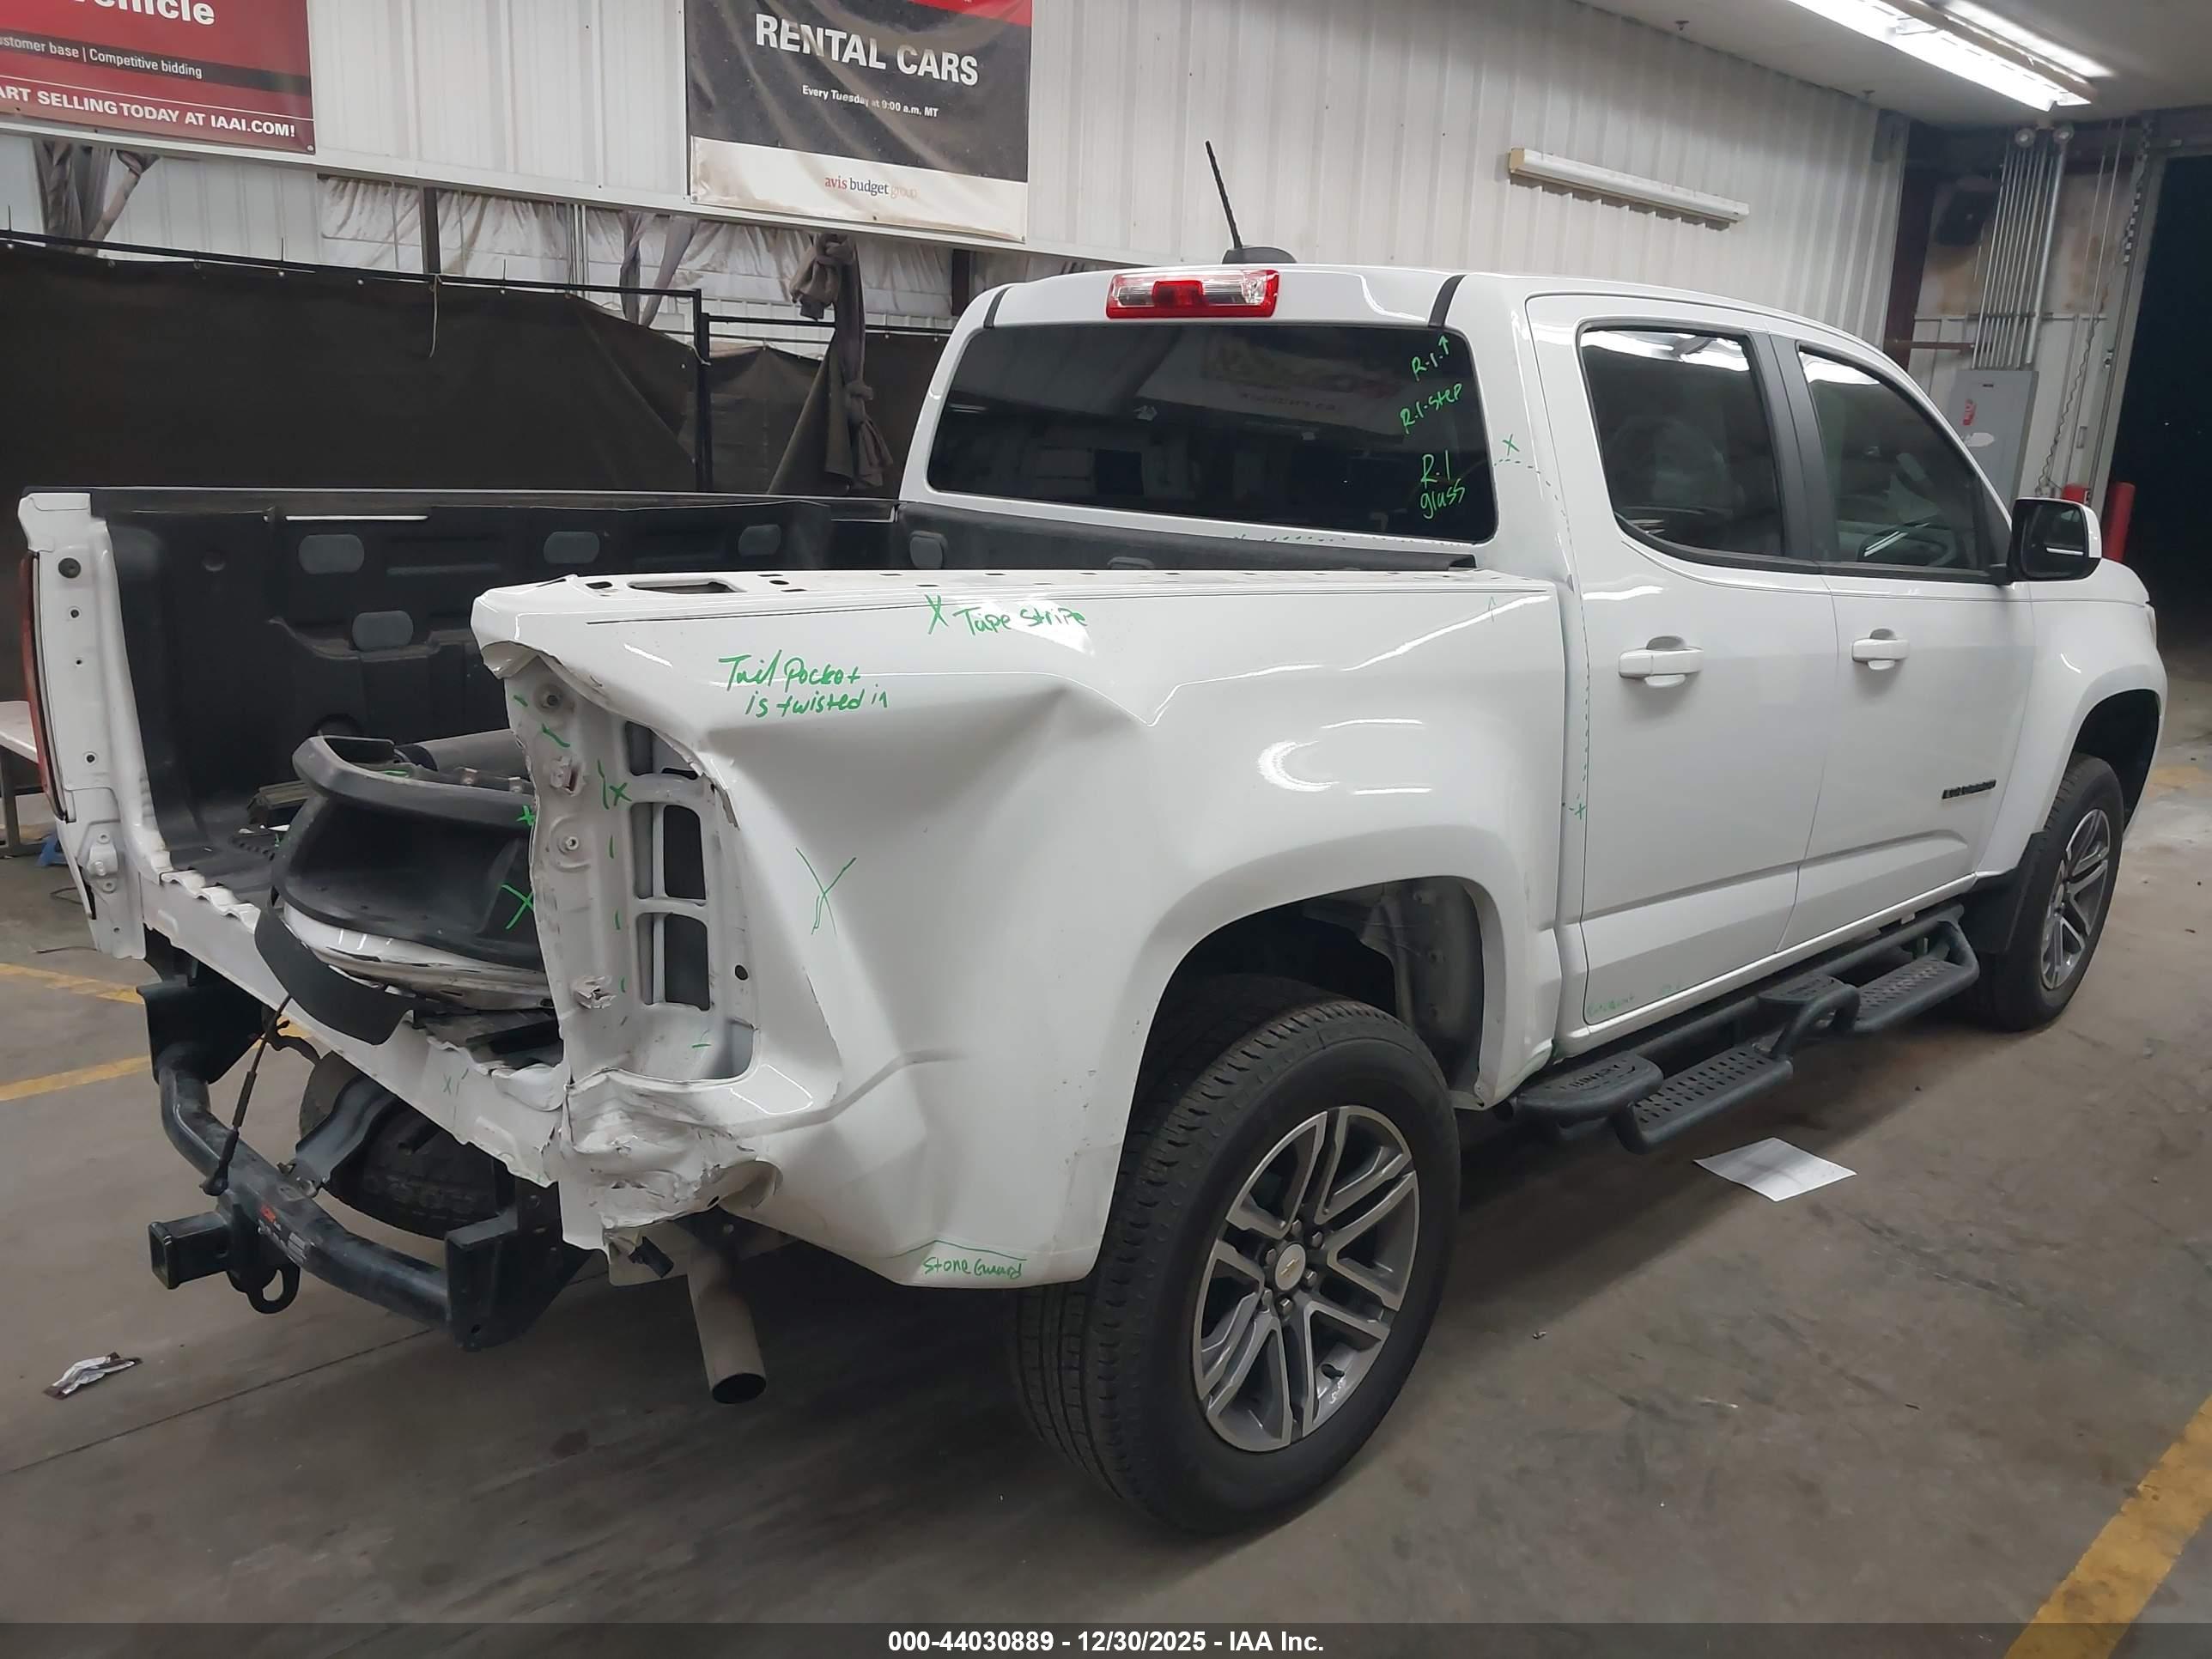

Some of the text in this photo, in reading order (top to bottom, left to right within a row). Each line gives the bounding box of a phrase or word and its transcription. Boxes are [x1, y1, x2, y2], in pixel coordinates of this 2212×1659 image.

[49, 41, 79, 58] base
[89, 48, 158, 70] Competitive
[161, 59, 203, 79] bidding
[756, 13, 978, 87] RENTAL CARS
[38, 90, 118, 115] SELLING
[118, 102, 179, 124] TODAY
[185, 112, 206, 126] AT
[210, 115, 295, 137] IAAI.COM!
[802, 85, 829, 100] Every
[831, 89, 869, 107] Tuesday
[902, 105, 922, 115] a.m.
[924, 106, 939, 117] MT
[824, 175, 848, 189] avis
[849, 177, 890, 197] budget
[718, 648, 782, 691] Tail
[745, 690, 769, 718] is
[776, 688, 866, 717] twisted
